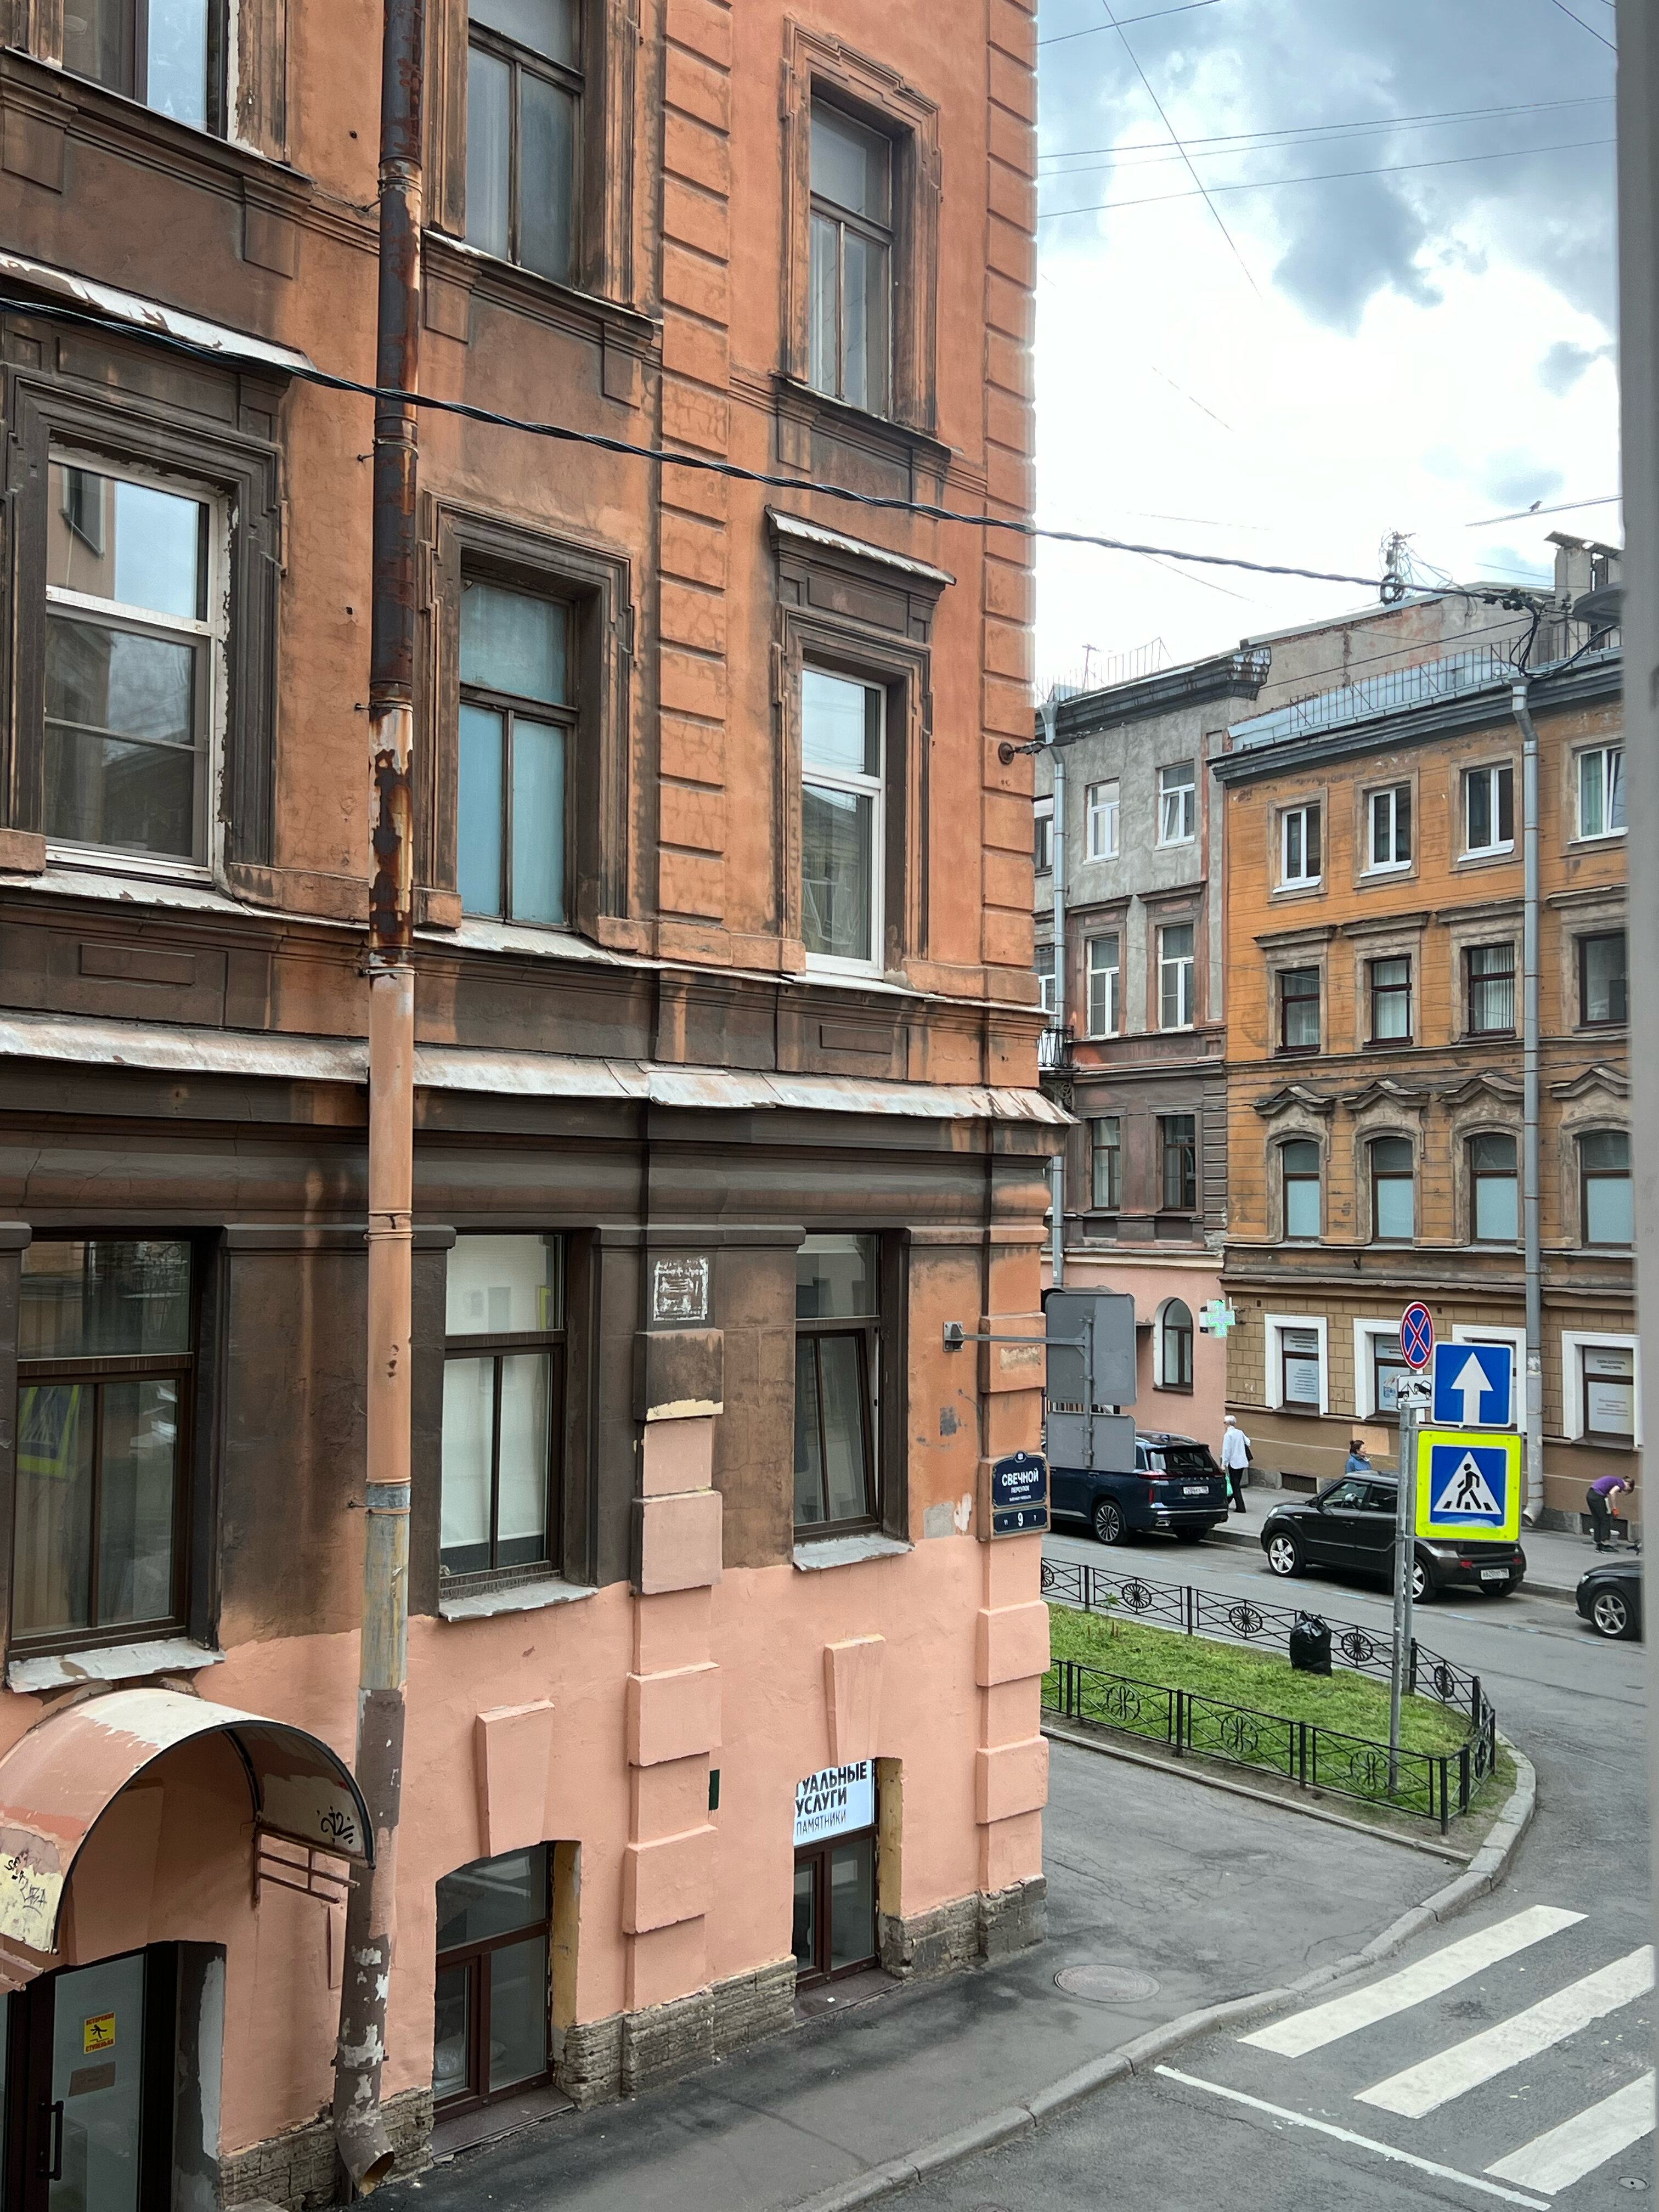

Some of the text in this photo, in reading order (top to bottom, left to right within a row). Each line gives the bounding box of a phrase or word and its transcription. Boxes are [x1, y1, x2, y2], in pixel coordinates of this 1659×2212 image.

[1002, 1467, 1039, 1486] СВЕЧНОЙ
[1018, 1512, 1024, 1527] 9
[795, 1786, 847, 1818] УСЛУГИ
[797, 1809, 847, 1837] ПАМЯТНИКИ
